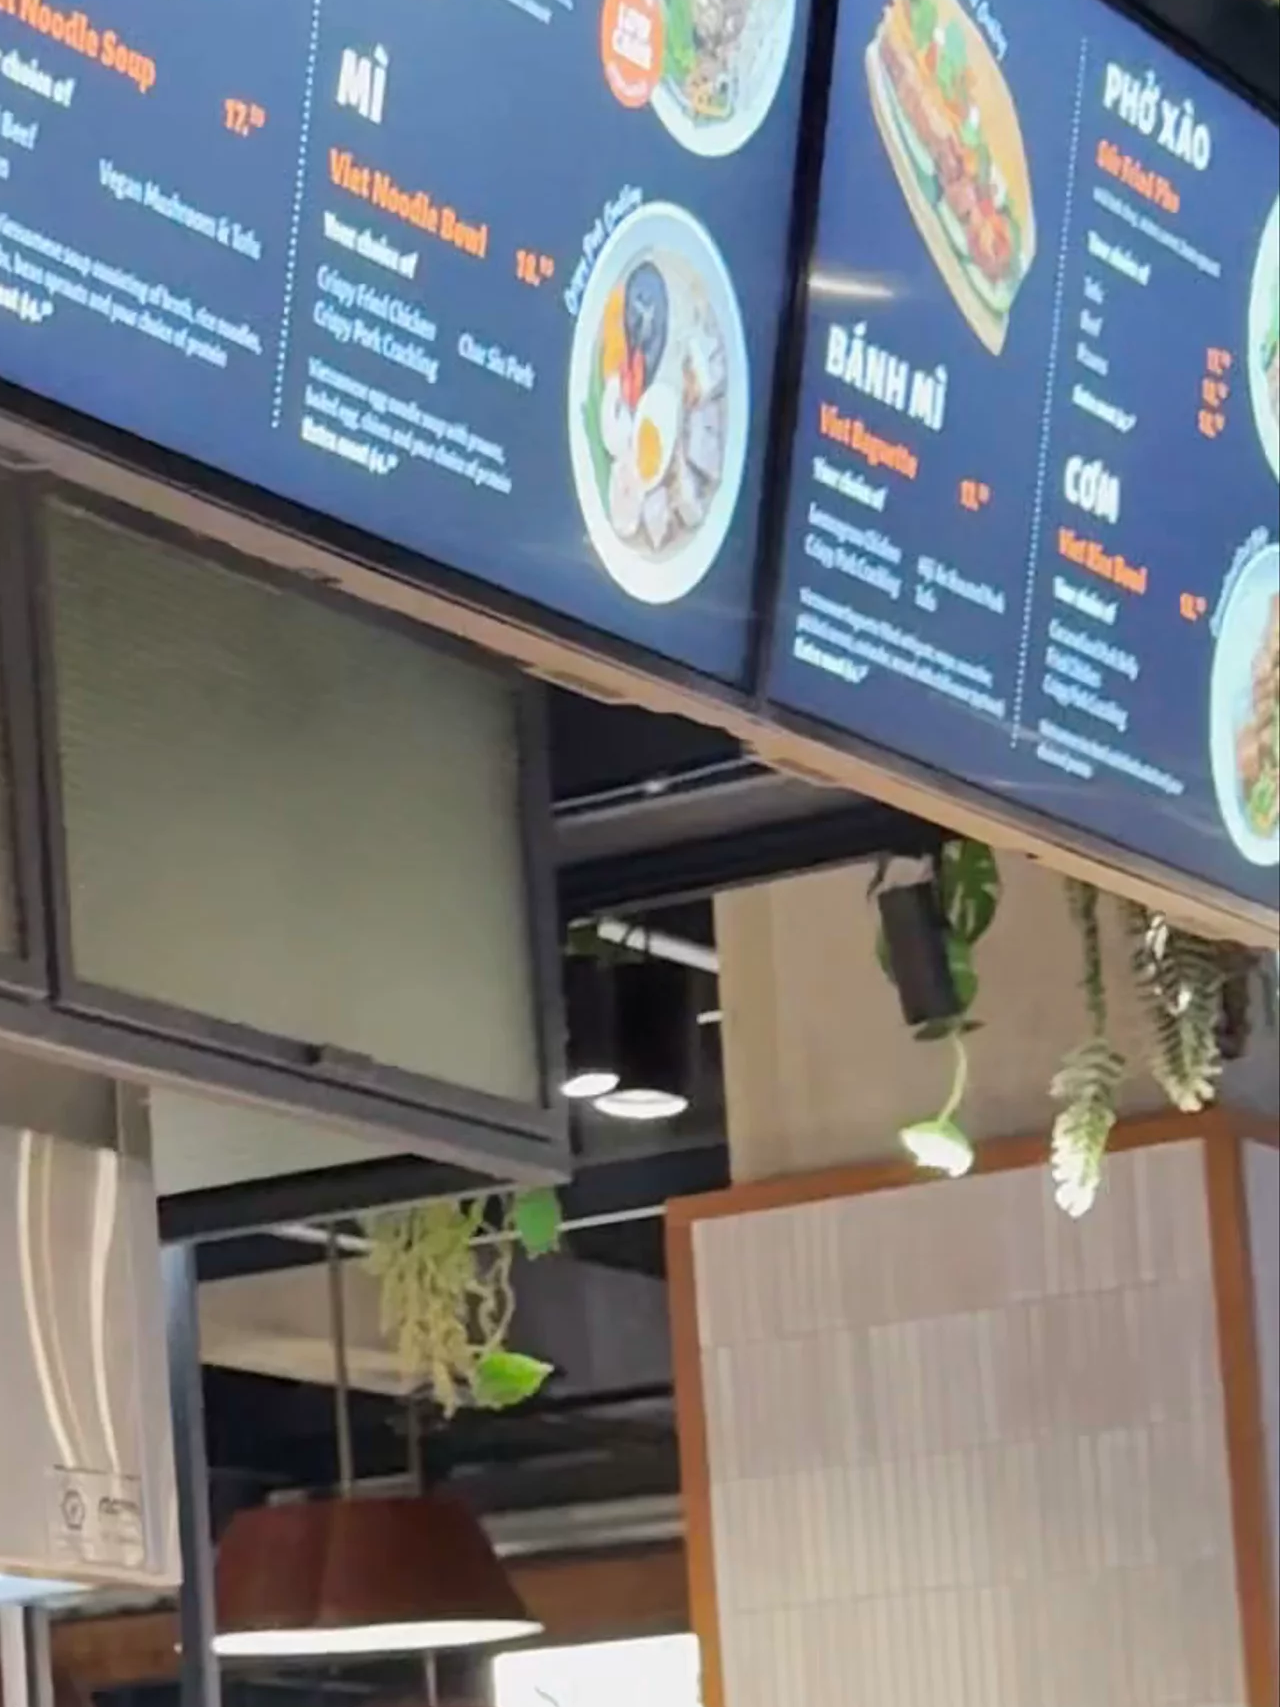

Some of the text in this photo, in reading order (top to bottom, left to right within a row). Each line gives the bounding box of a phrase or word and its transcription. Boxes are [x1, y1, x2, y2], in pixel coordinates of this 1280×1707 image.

[1, 51, 54, 97] choice
[52, 79, 74, 106] of
[99, 31, 155, 92] Soup
[337, 46, 388, 123] MÌ
[1, 111, 37, 148] Beef
[1104, 64, 1160, 143] PHỞ
[100, 160, 142, 201] Vegan
[144, 182, 217, 237] Mushroom
[232, 223, 260, 259] Tofu
[331, 149, 487, 257] Viet Noodle Bowl
[317, 265, 436, 341] Crispy Fried Chicken
[313, 301, 438, 383] Crispy Pork Crackling
[826, 323, 946, 429] BÁNH MÌ
[1065, 457, 1119, 522] CƠM
